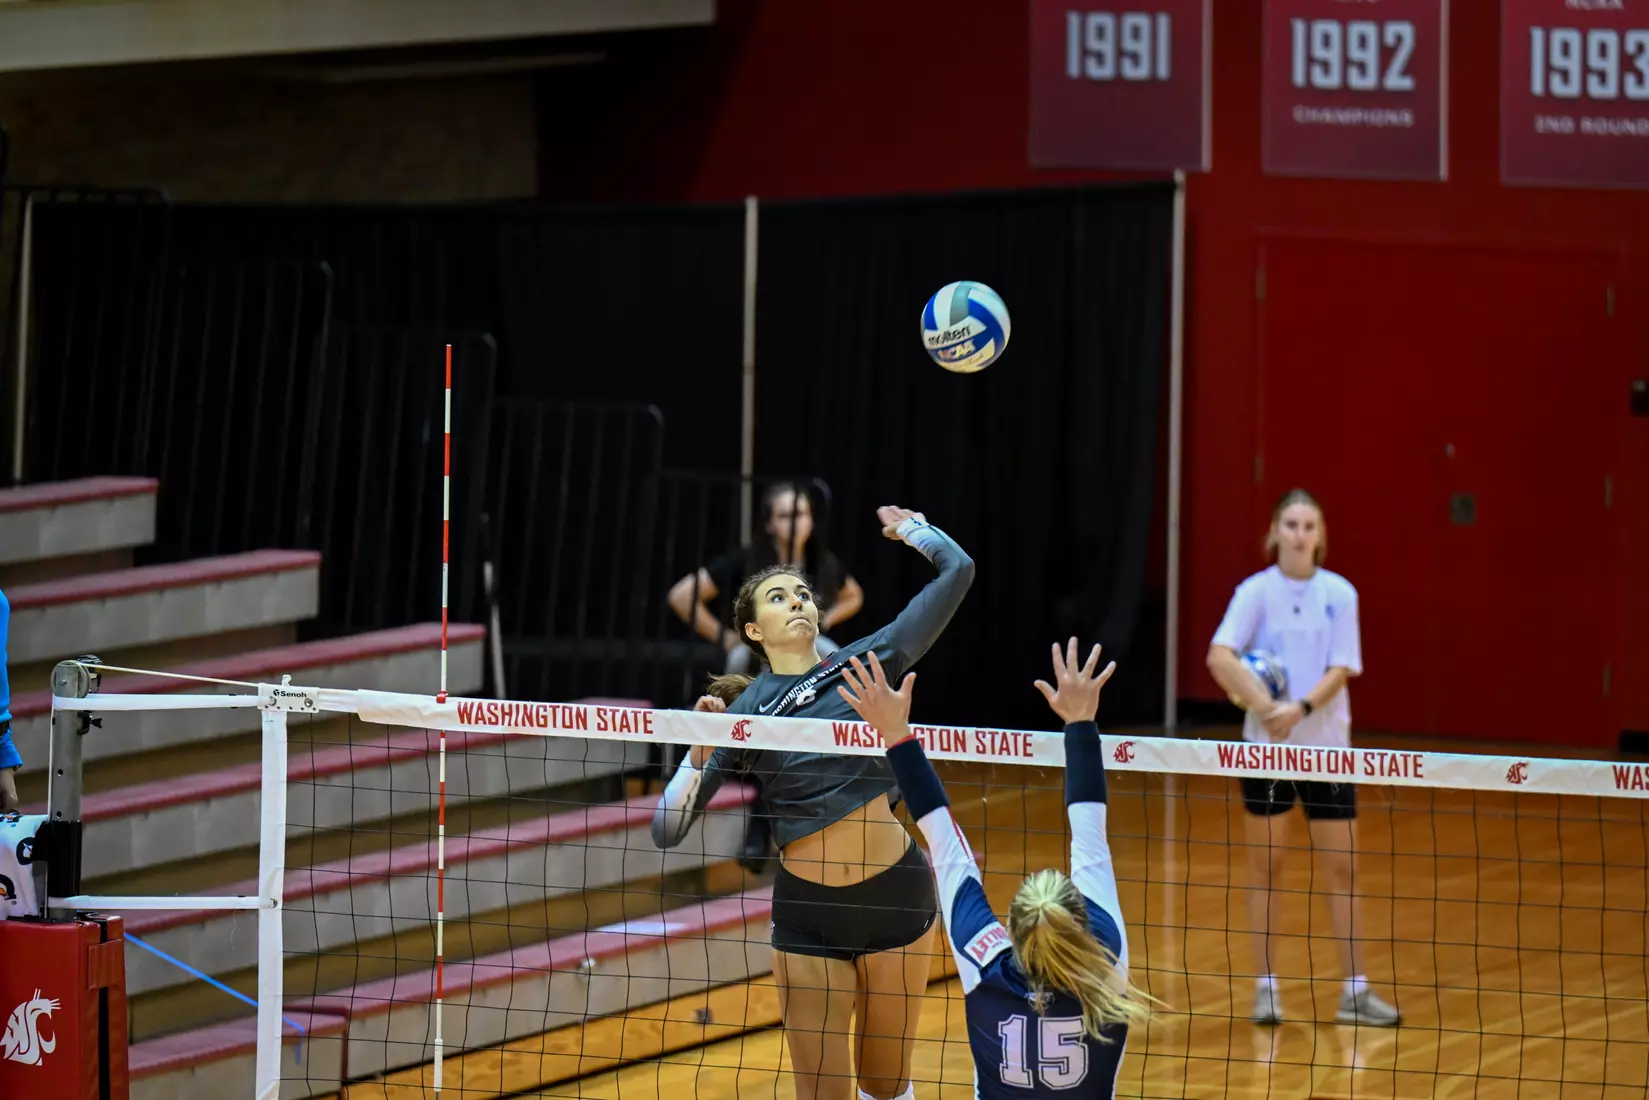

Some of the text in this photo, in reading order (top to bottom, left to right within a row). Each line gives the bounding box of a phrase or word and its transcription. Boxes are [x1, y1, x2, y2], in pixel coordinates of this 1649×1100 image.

[1066, 10, 1171, 80] 1991
[1291, 17, 1416, 91] 1992
[1530, 25, 1649, 99] 1993
[1293, 105, 1414, 127] CHAMPIONS
[1534, 114, 1649, 137] 2ND ROUND
[280, 690, 307, 698] Senoh
[457, 701, 654, 735] WASHINGTON STATE
[832, 721, 1034, 758] WASHGTON STATE
[1217, 743, 1424, 779] WASHINGTON STATE
[998, 1013, 1089, 1090] 15
